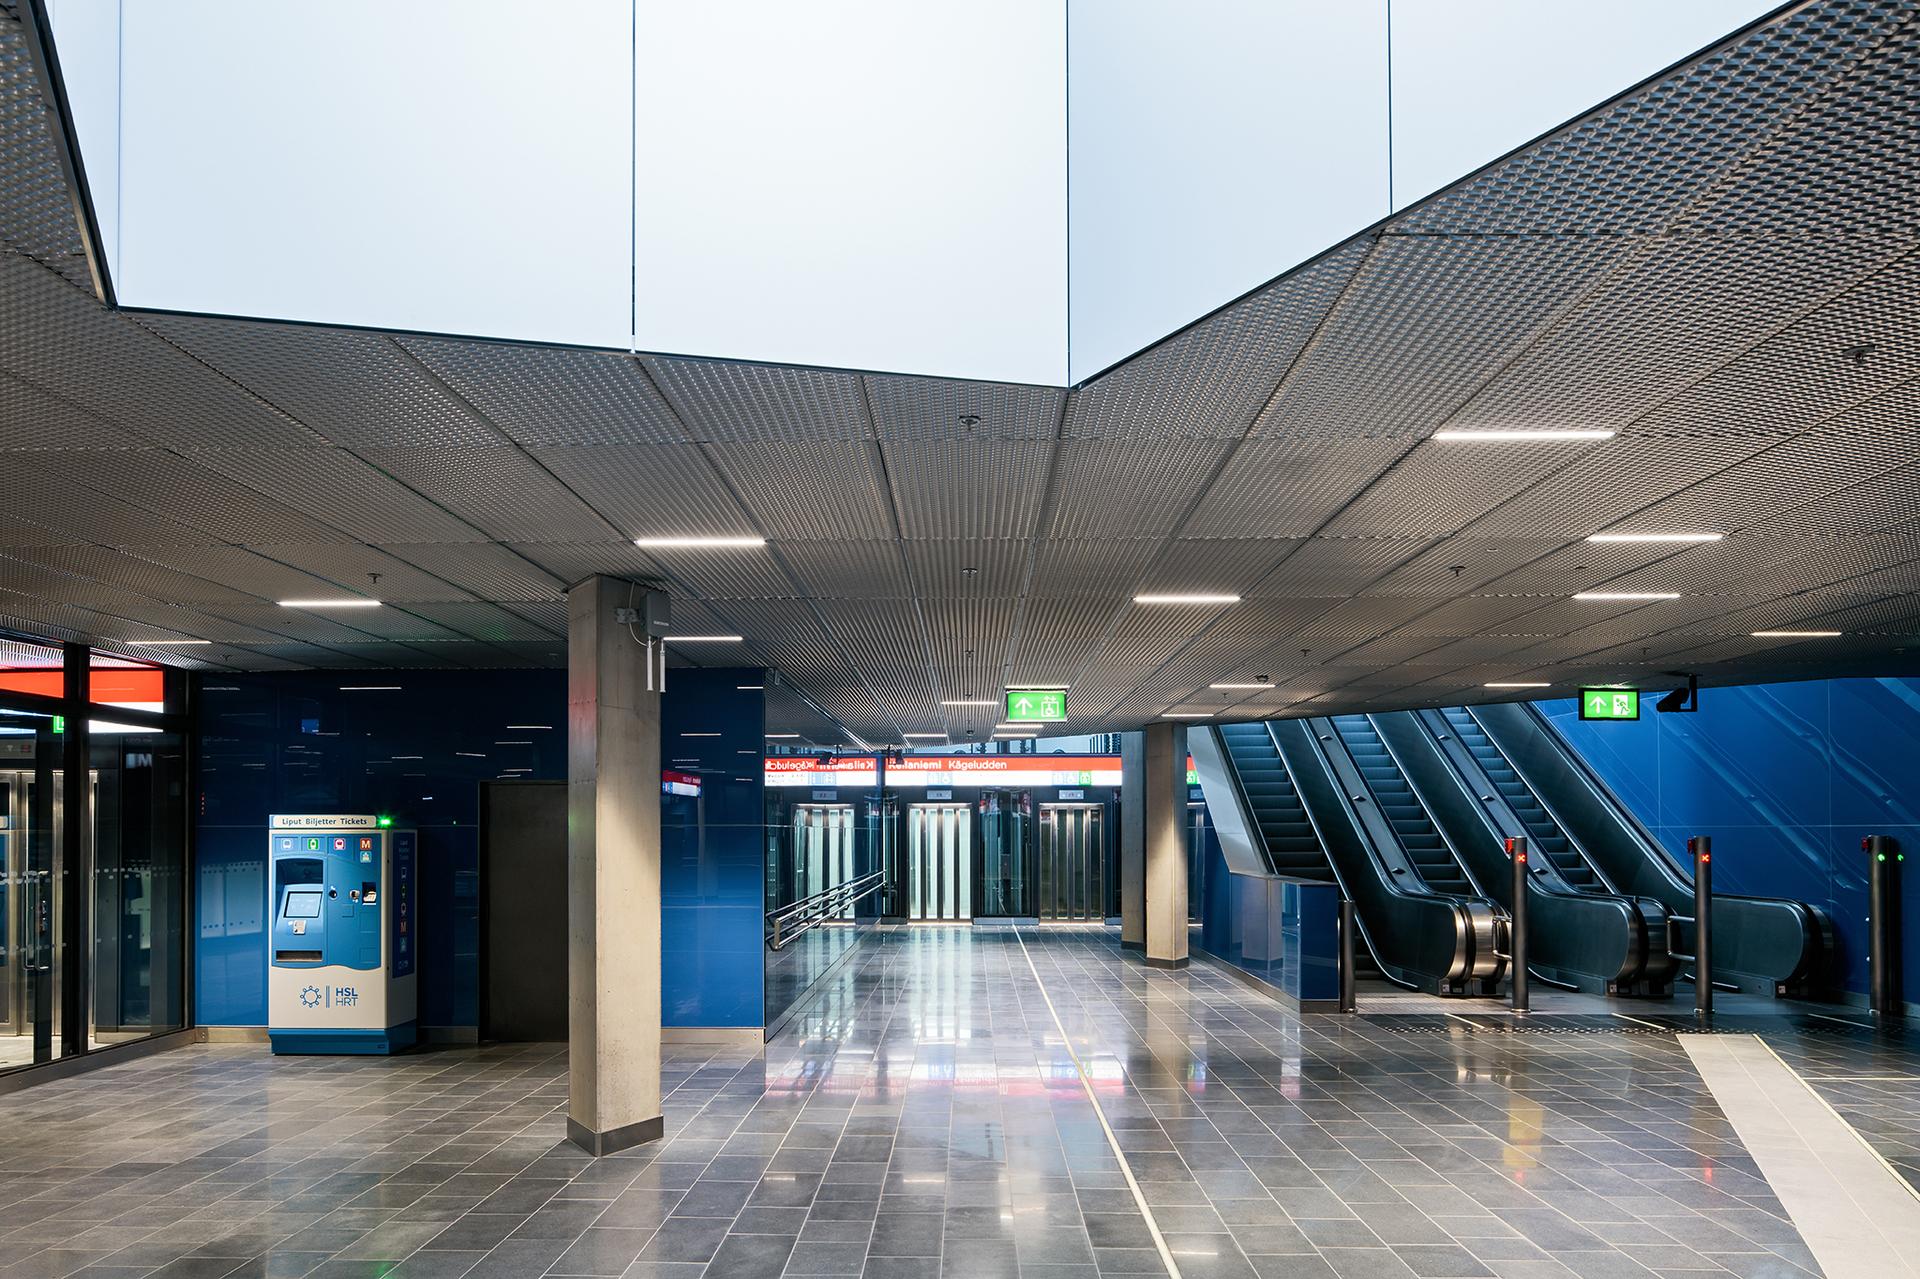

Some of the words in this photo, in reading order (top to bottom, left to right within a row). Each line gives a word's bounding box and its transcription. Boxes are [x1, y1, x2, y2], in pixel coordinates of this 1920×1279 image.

[948, 760, 1007, 771] Kågeludden
[282, 818, 302, 827] Liput
[305, 818, 336, 827] Biljetter
[340, 818, 367, 826] Tickets
[335, 987, 358, 997] HSL
[335, 997, 358, 1007] HRT
